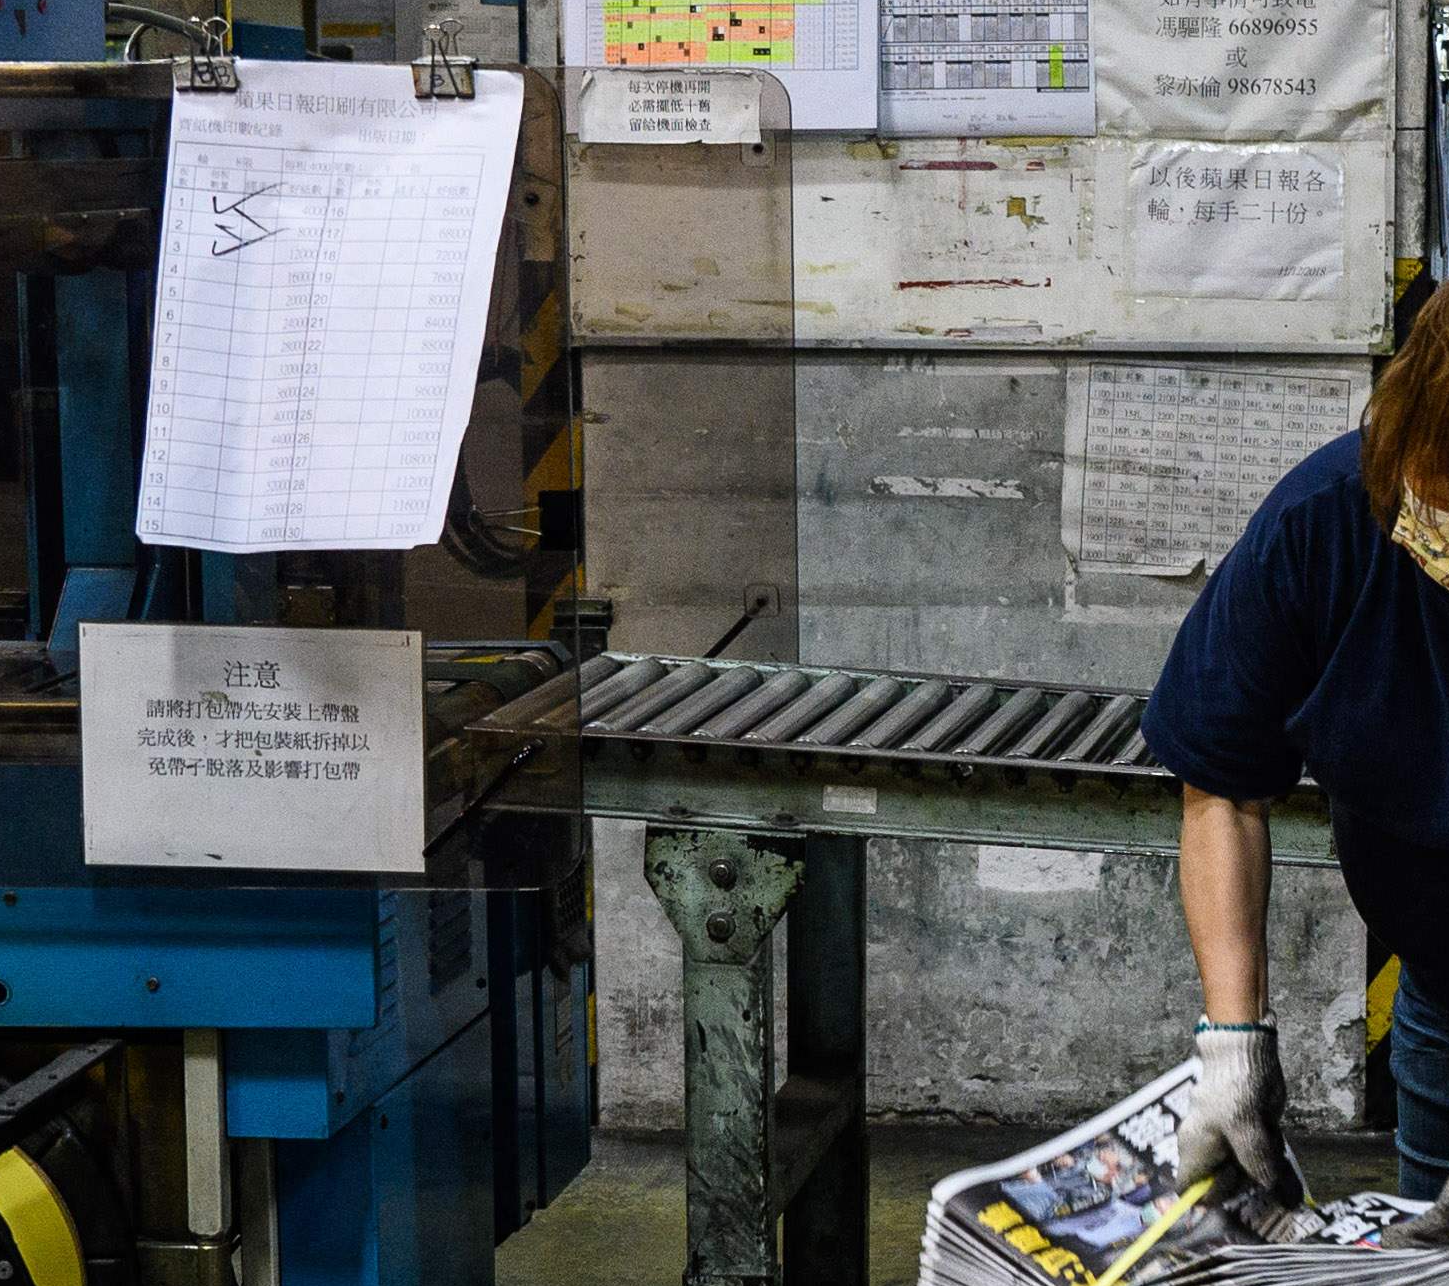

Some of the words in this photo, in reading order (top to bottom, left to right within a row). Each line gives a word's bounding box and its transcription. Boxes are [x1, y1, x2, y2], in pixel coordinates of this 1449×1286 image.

[1228, 17, 1318, 36] 66896955
[1225, 46, 1248, 68] 或
[1228, 77, 1317, 96] 98678543
[235, 91, 439, 120] 蘋果日報印刷有限公司
[1149, 166, 1326, 192] 以後蘋果日報各
[330, 207, 344, 218] 16
[176, 219, 183, 230] 2
[327, 228, 341, 239] 17
[173, 241, 180, 252] 3
[322, 250, 336, 261] 18
[170, 264, 178, 274] 4
[319, 272, 333, 283] 19
[168, 287, 176, 297] 5
[314, 294, 328, 305] 20
[166, 310, 174, 321] 6
[310, 317, 324, 329] 21
[164, 333, 172, 343] 7
[307, 339, 321, 351] 22
[162, 356, 170, 367] 8
[303, 363, 318, 374] 23
[159, 380, 168, 391] 9
[300, 386, 315, 397] 24
[156, 403, 170, 414] 10
[298, 409, 312, 421] 25
[154, 426, 167, 437] 11
[296, 433, 310, 444] 26
[151, 449, 166, 461] 12
[294, 456, 308, 467] 27
[149, 472, 163, 484] 13
[291, 479, 305, 490] 28
[146, 496, 161, 507] 14
[289, 503, 303, 514] 29
[144, 520, 159, 530] 15
[286, 526, 300, 539] 30
[222, 659, 281, 690] 注意
[145, 698, 360, 724] 請將打包帶先安裝上帶盤
[136, 729, 371, 753] 完成後，才把包裝紙拆掉以
